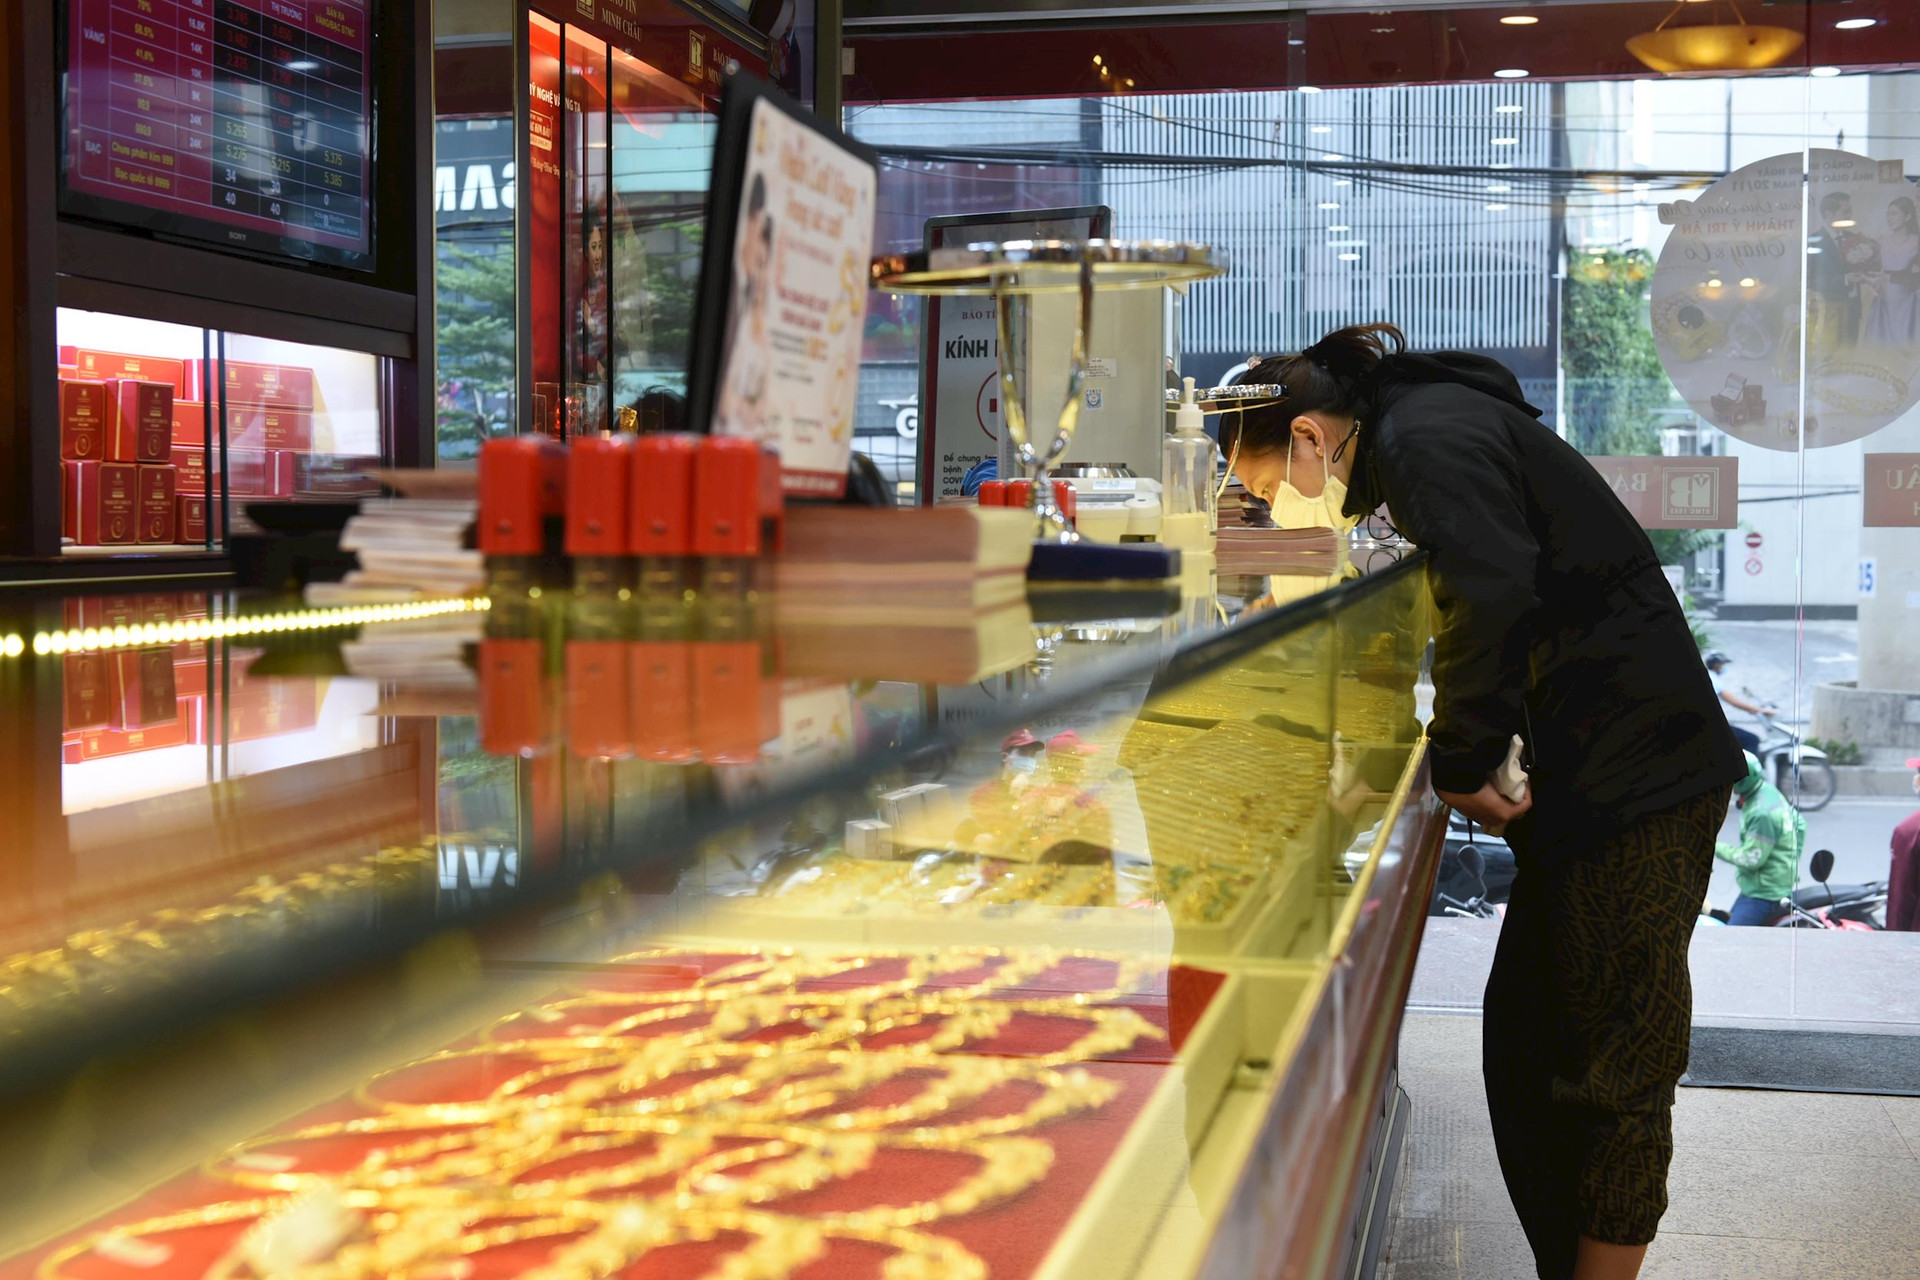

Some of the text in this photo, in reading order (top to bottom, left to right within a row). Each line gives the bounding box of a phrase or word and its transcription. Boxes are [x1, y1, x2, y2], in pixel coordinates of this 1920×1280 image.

[601, 7, 622, 31] MINH
[622, 18, 643, 42] CHÂU
[84, 26, 105, 44] VÀNG
[712, 47, 723, 66] BẢO
[536, 86, 554, 107] NGHỆ
[324, 150, 343, 167] 5.375
[225, 168, 237, 183] 34
[324, 171, 343, 187] 5.385
[225, 191, 237, 206] 40
[323, 194, 329, 206] 0
[270, 202, 281, 216] 40
[962, 307, 983, 320] BẢO
[945, 334, 989, 359] KÍNH
[957, 454, 981, 462] chung
[943, 465, 962, 475] bệnh
[942, 488, 959, 496] dịch
